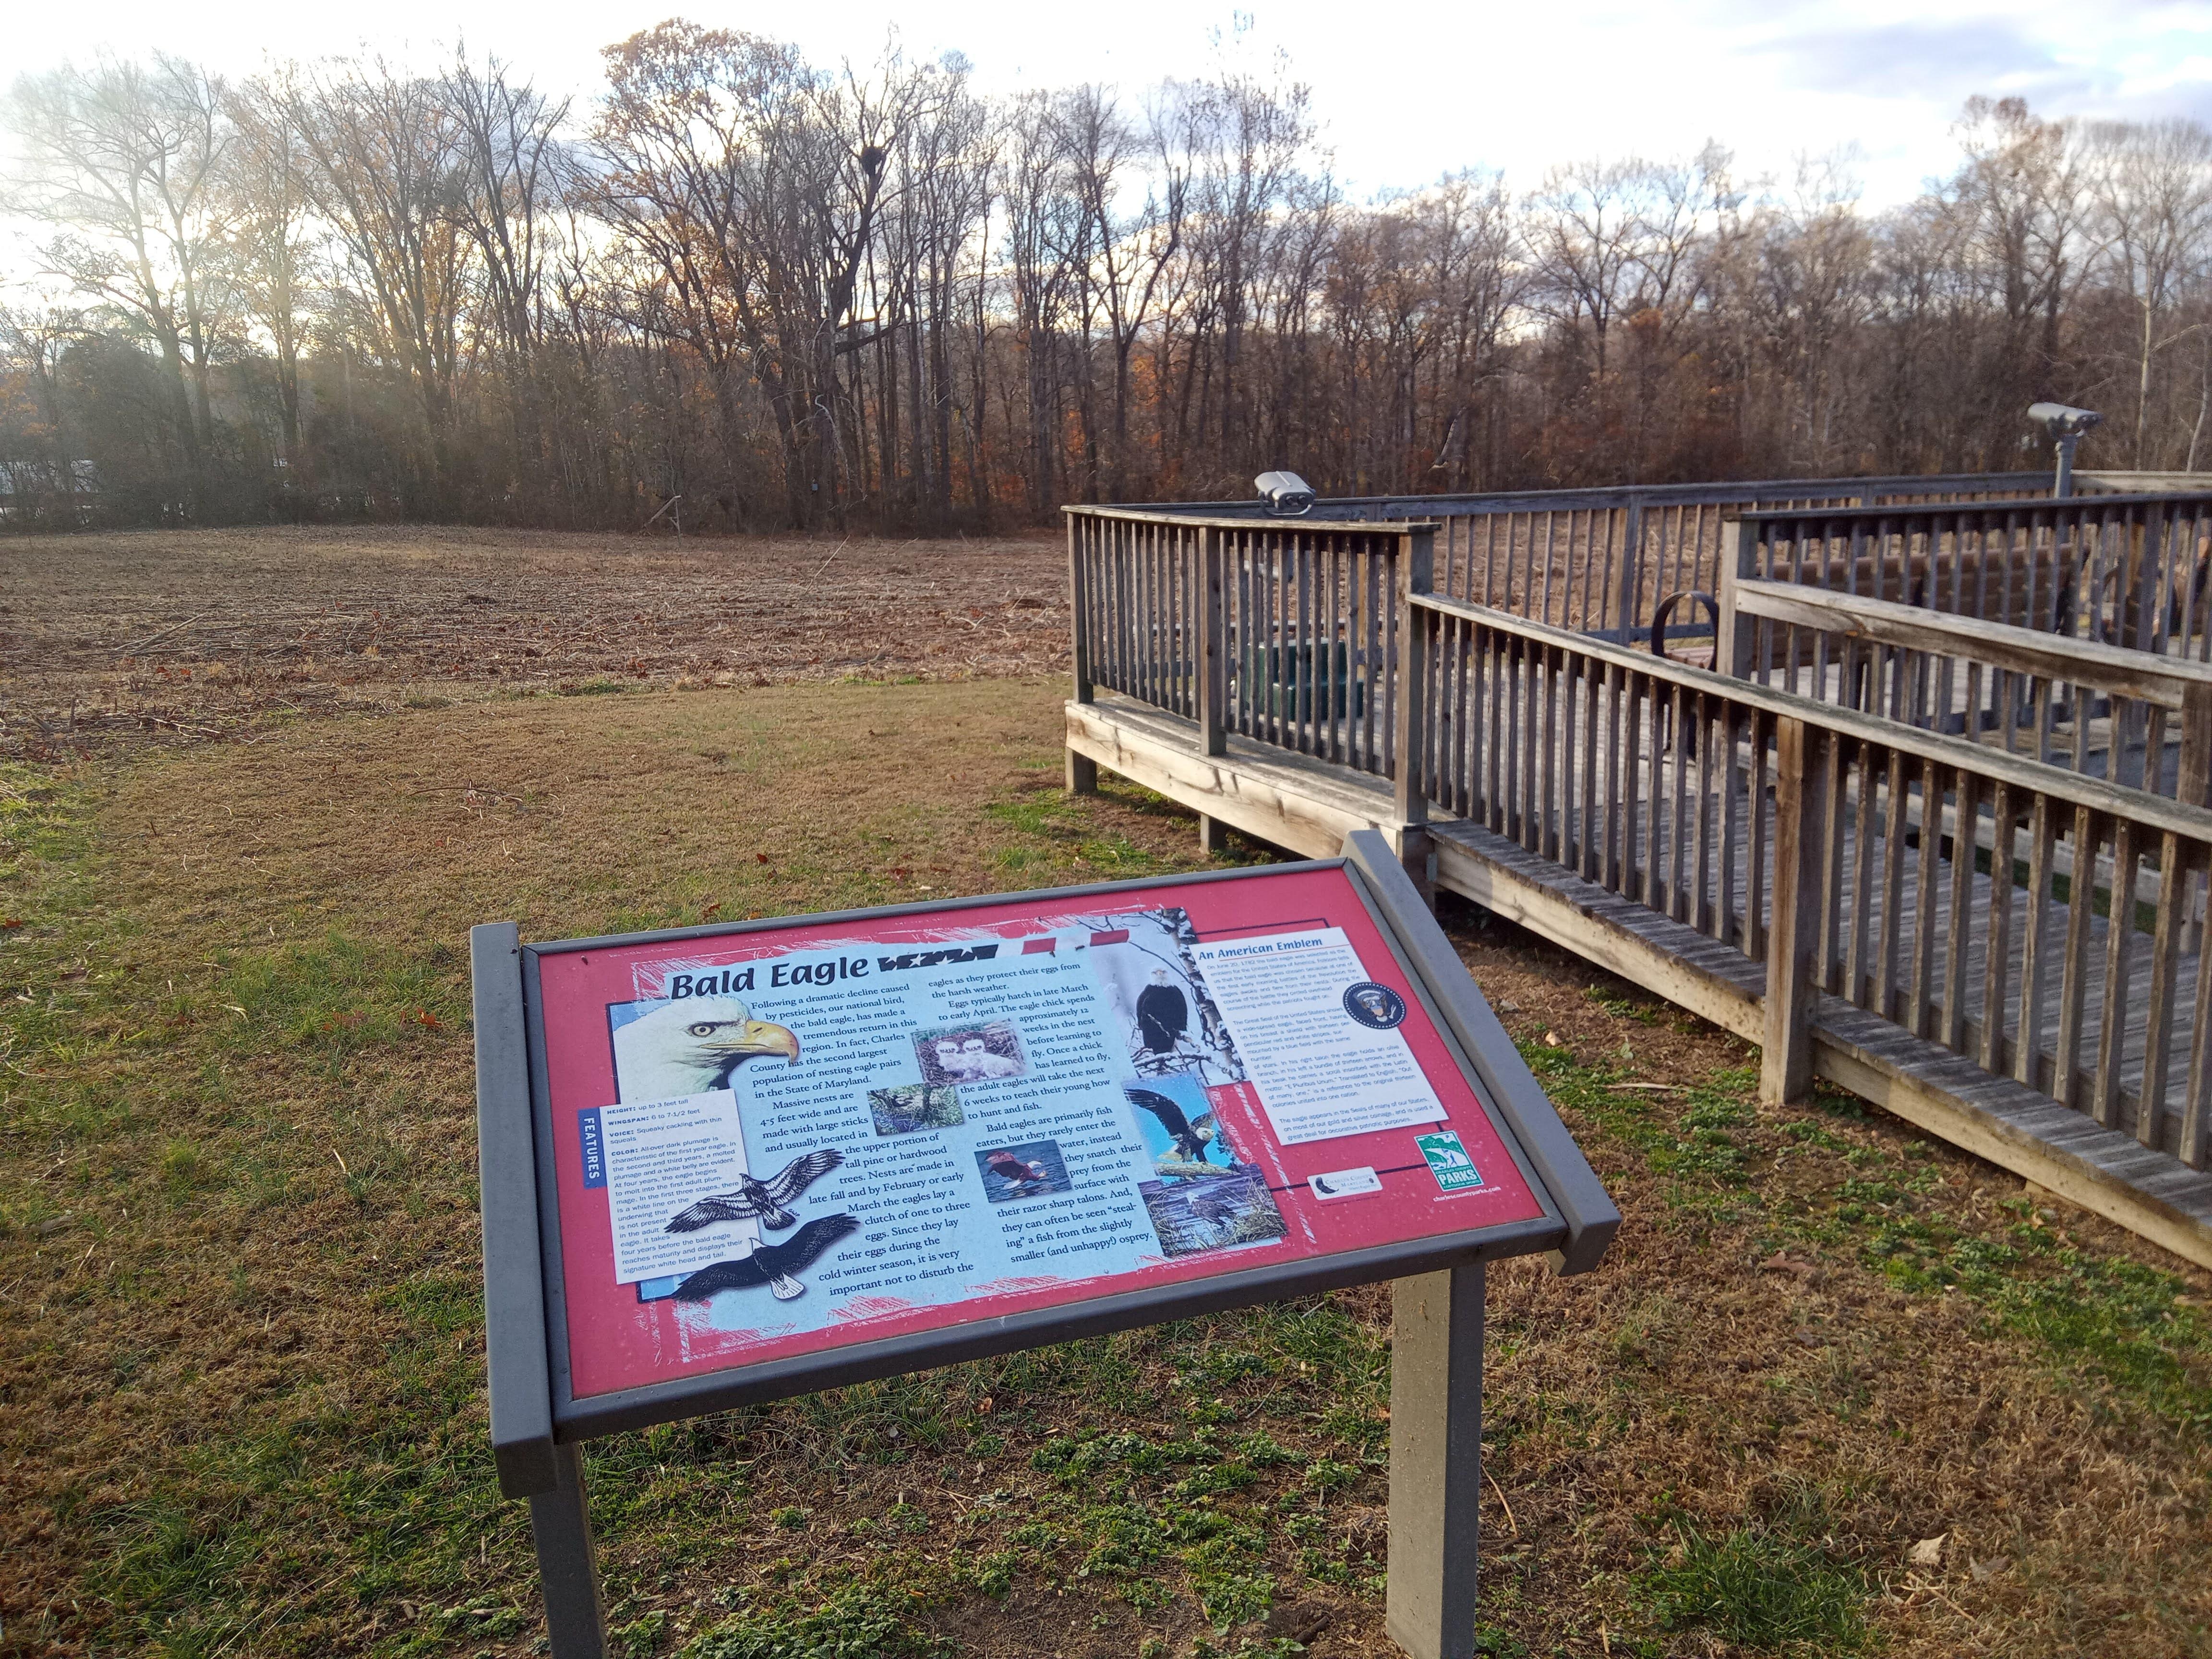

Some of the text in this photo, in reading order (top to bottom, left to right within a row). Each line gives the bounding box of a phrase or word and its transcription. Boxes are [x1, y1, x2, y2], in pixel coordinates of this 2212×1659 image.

[1198, 938, 1322, 960] An American Emblem
[672, 957, 869, 999] Bald Eagle
[928, 978, 954, 988] eagles
[965, 974, 985, 983] they
[986, 971, 1017, 982] protect
[1019, 967, 1038, 975] their
[1040, 966, 1058, 974] eggs
[750, 998, 797, 1010] Following
[805, 992, 845, 1002] dramatic
[847, 988, 878, 998] decline
[880, 983, 910, 993] caused
[947, 987, 972, 996] harsh
[973, 984, 1010, 993] weather.
[947, 1000, 969, 1009] Eggs
[970, 994, 1005, 1007] typically
[1007, 991, 1032, 1000] hatch
[1060, 983, 1089, 993] March
[764, 1012, 777, 1021] by
[779, 1007, 826, 1020] pesticides,
[845, 998, 882, 1010] national
[882, 996, 904, 1005] bird,
[806, 1017, 828, 1027] bald
[829, 1015, 855, 1025] eagle,
[874, 1009, 898, 1018] made
[1019, 1008, 1078, 1023] approximately
[803, 1028, 857, 1040] tremendous
[859, 1024, 888, 1033] return
[900, 1019, 917, 1027] this
[801, 1044, 833, 1054] region.
[870, 1033, 905, 1043] Charles
[1050, 1055, 1084, 1067] learned
[1096, 1052, 1111, 1061] fly,
[752, 1059, 902, 1088] population of nesting eagle pairs
[606, 1106, 636, 1115] HEIGHT:
[771, 1098, 811, 1110] Massive
[813, 1095, 837, 1104] nests
[608, 1116, 649, 1126] WINGSPAN:
[636, 1125, 664, 1133] Squeaky
[666, 1121, 693, 1129] cackling
[985, 1121, 1008, 1132] Bald
[1009, 1118, 1036, 1130] eagles
[1053, 1109, 1094, 1124] primarily
[1095, 1106, 1113, 1115] fish
[610, 1136, 637, 1144] squeals
[683, 1138, 710, 1147] plumage
[975, 1138, 1006, 1147] eaters,
[1025, 1131, 1046, 1140] they
[1047, 1125, 1073, 1136] rarely
[1075, 1123, 1099, 1131] enter
[1100, 1119, 1116, 1128] the
[584, 1118, 600, 1179] FEATURES
[612, 1153, 657, 1164] characteristic
[1074, 1173, 1130, 1191] surface with
[1437, 1170, 1477, 1185] PARKS
[997, 1187, 1133, 1217] their razor sharp talons. And,
[1432, 1186, 1502, 1202] charlescountyparks.com
[865, 1218, 959, 1242] eggs. Since they lay
[837, 1237, 940, 1261] their eggs during the
[1010, 1232, 1153, 1262] smaller (and unhappy!) osprey.
[623, 1264, 656, 1274] signature
[678, 1256, 696, 1264] head
